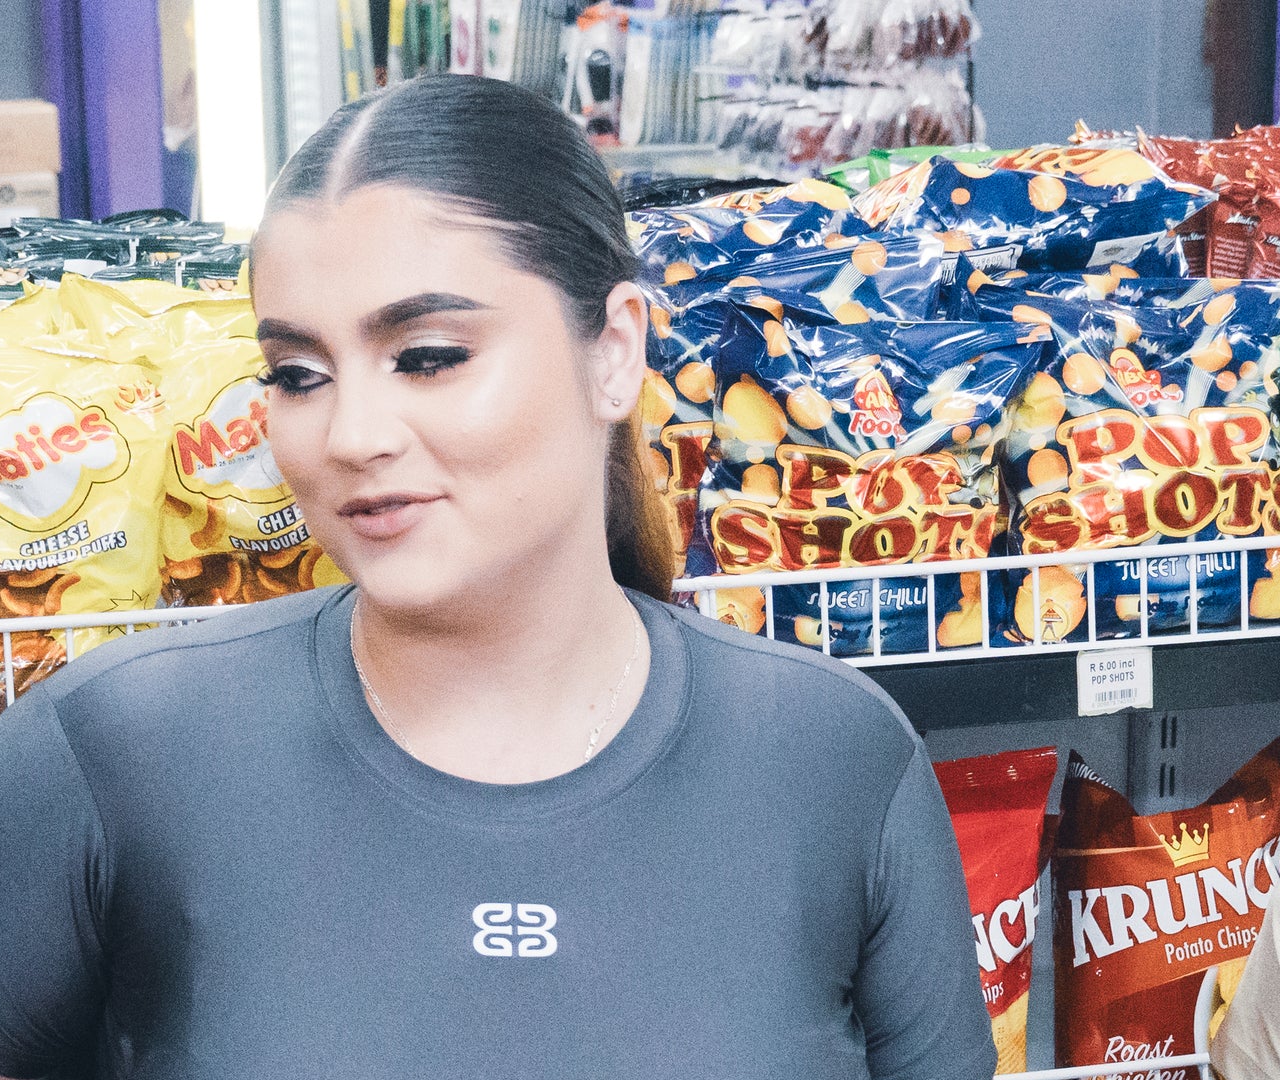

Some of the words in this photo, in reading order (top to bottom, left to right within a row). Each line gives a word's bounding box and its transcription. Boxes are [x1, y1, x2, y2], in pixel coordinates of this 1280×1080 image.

[176, 398, 270, 476] Mat
[1056, 405, 1271, 489] POP
[776, 445, 965, 516] POP
[257, 502, 304, 536] CHEE
[20, 519, 91, 558] CHEESE
[80, 530, 128, 558] PUFFS
[229, 524, 311, 553] FLAVOURE
[878, 585, 928, 611] CHILLI
[1091, 675, 1107, 685] POP
[1109, 671, 1135, 683] SHOTS
[972, 879, 1041, 972] NCH
[1164, 937, 1214, 964] Potato
[1217, 925, 1258, 949] Chips
[1104, 1033, 1175, 1063] Roast
